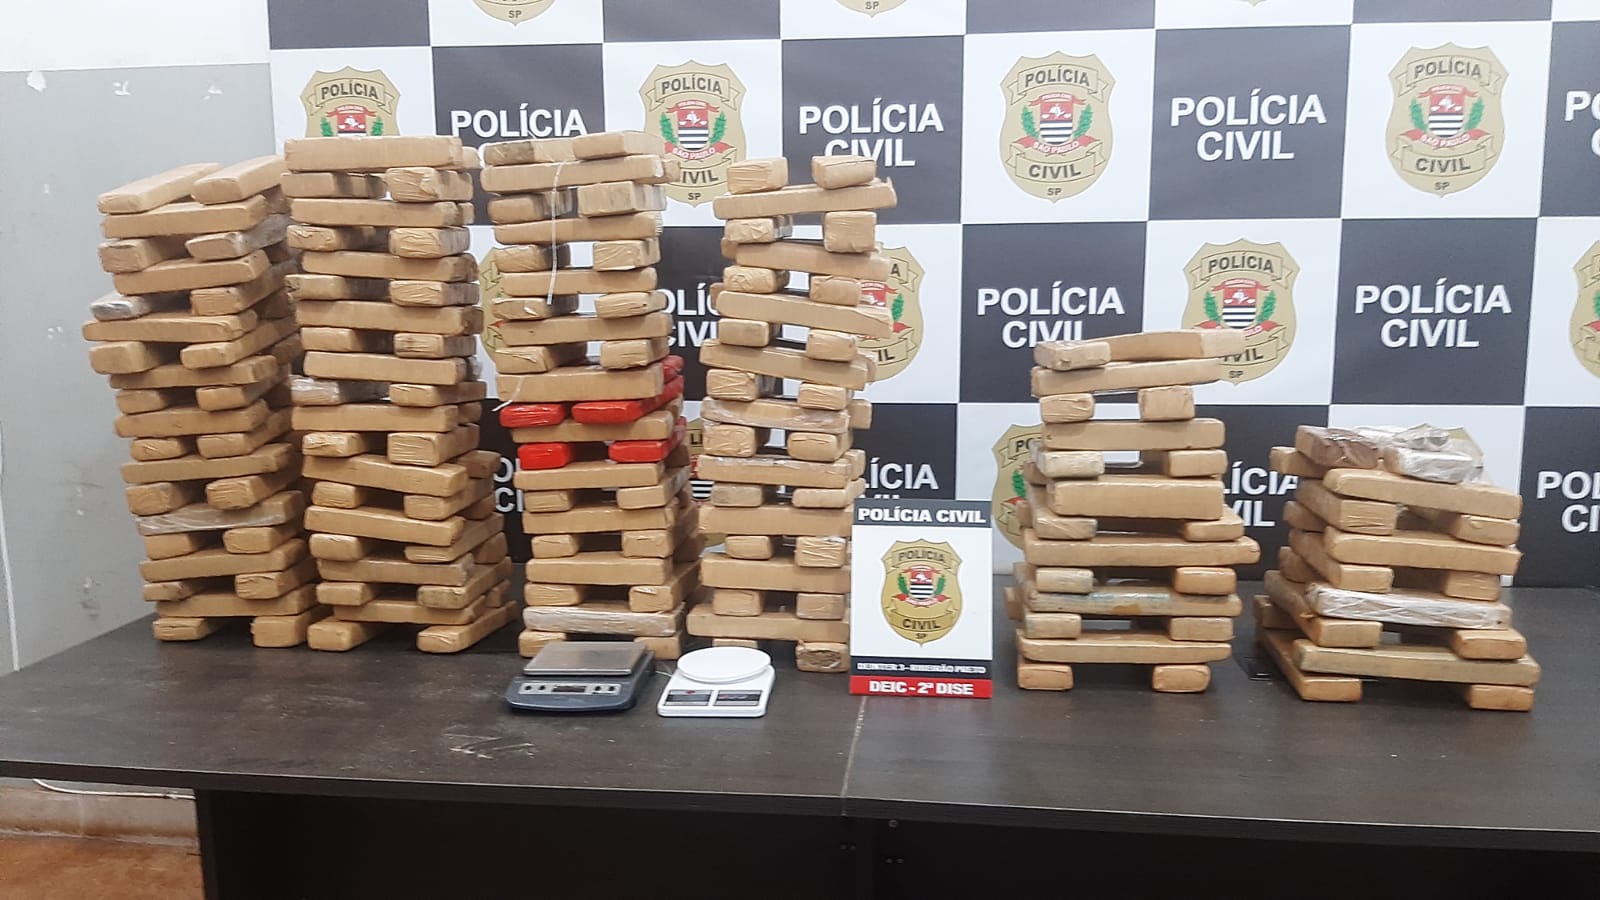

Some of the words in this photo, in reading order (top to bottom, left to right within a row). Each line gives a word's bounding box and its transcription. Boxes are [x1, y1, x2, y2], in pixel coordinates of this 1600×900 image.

[508, 10, 522, 19] SP
[865, 1, 879, 10] SP
[1025, 65, 1090, 87] POLÍCIA
[1415, 55, 1482, 79] POLÍCIA
[321, 79, 378, 100] POLÍCIA
[662, 74, 722, 95] POLÍCIA
[799, 97, 944, 134] POLÍCIA
[1170, 88, 1327, 127] POLÍCIA
[451, 103, 588, 138] POLÍCIA
[1197, 130, 1295, 161] CIVIL
[1029, 164, 1082, 179] CIVIL
[1416, 157, 1471, 173] CIVIL
[682, 169, 719, 184] IVIL
[1434, 182, 1450, 191] SP
[688, 192, 701, 200] SP
[1047, 188, 1062, 196] SP
[1208, 252, 1274, 273] POLÍCIA
[977, 280, 1125, 316] POLÍCIA
[1354, 277, 1512, 314] POLÍCIA
[1381, 318, 1480, 348] CIVIL
[1228, 370, 1244, 379] SP
[865, 457, 939, 490] ÍCIA
[1223, 461, 1298, 496] ÍCIA
[858, 505, 932, 523] POLÍCIA
[936, 510, 986, 524] CIVIL
[902, 618, 942, 630] CIVIL
[869, 680, 907, 693] DEIC
[936, 682, 974, 695] DISE
